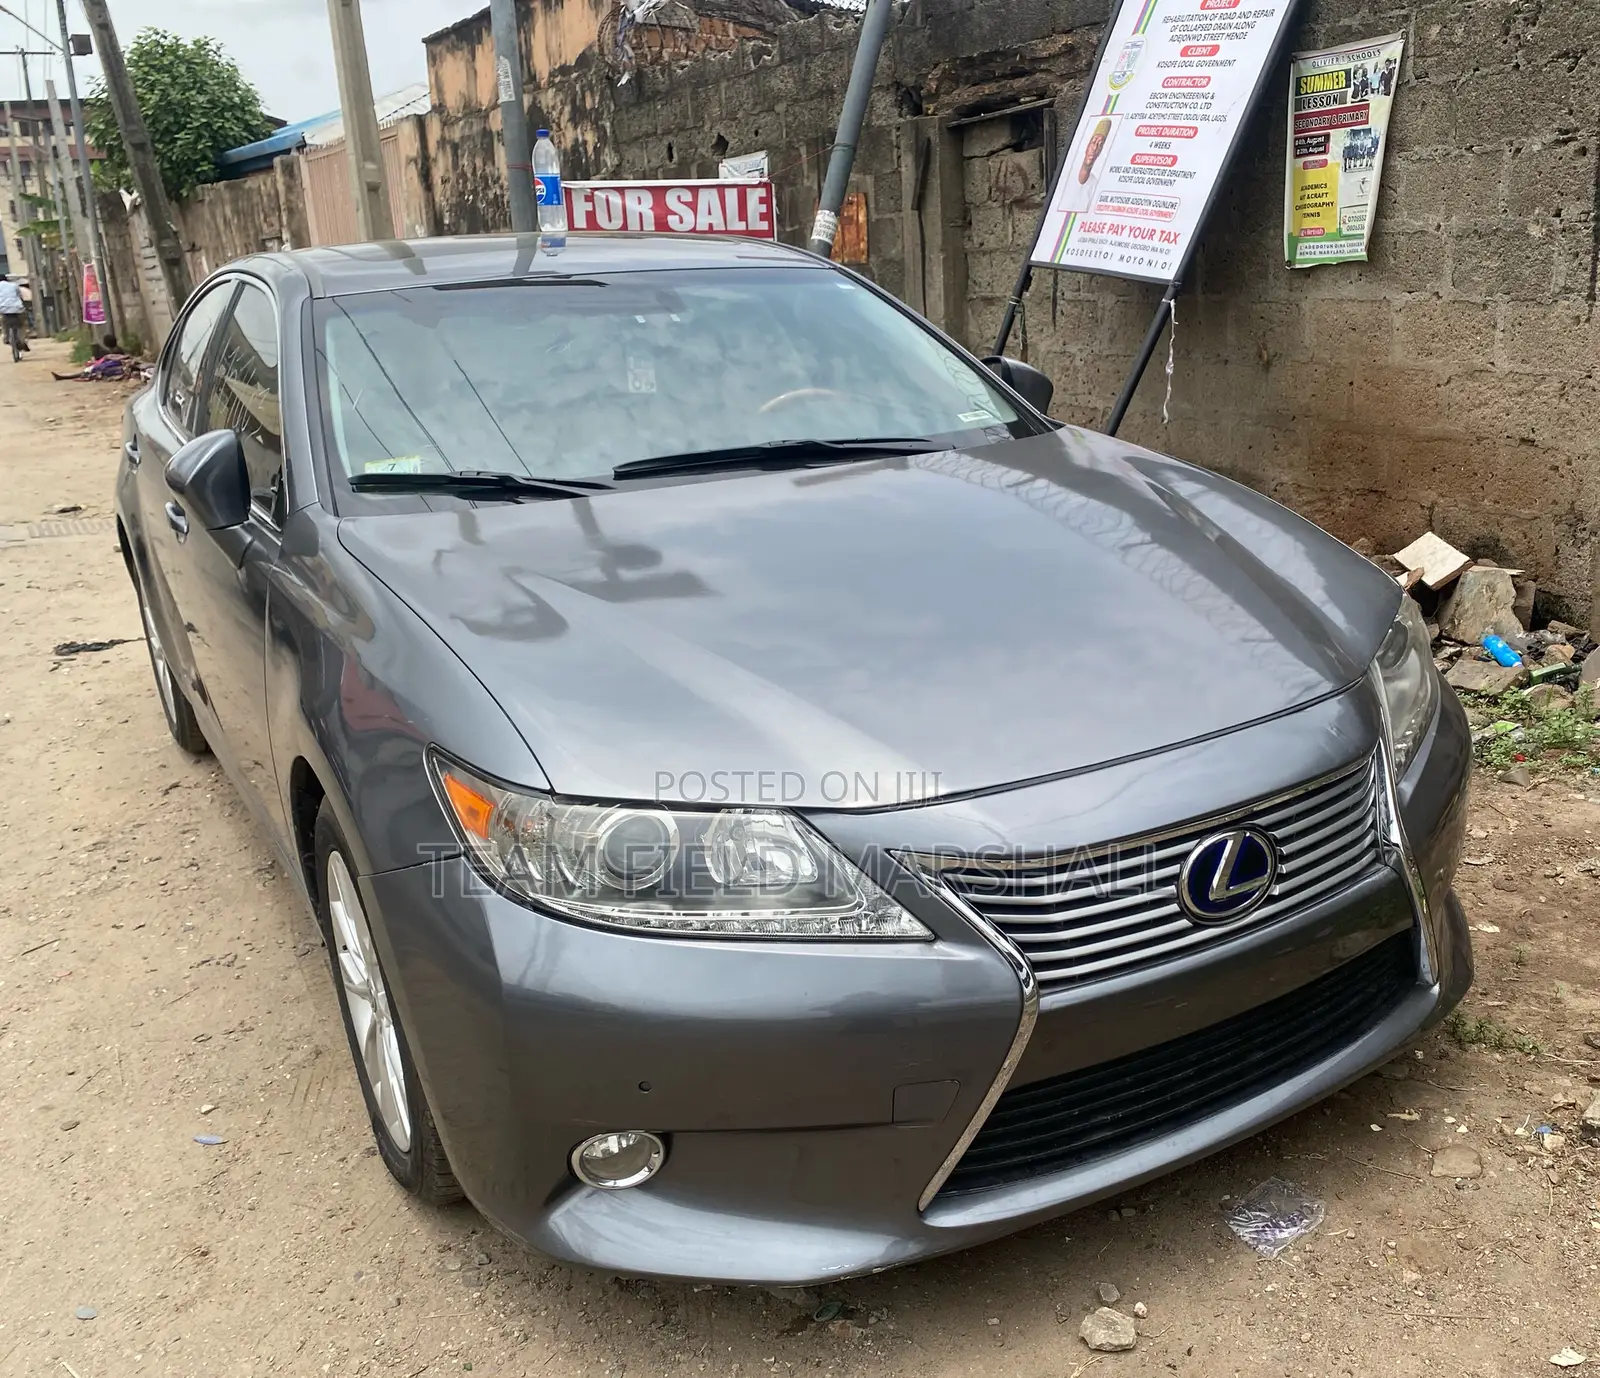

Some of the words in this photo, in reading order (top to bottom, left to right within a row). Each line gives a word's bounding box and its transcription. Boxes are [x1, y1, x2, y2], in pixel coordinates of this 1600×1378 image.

[1162, 14, 1208, 23] REHABILITATION
[1220, 12, 1236, 20] ROAD
[1252, 9, 1275, 18] REPAIR
[1179, 23, 1212, 32] COLLAPSED
[1233, 21, 1257, 30] ALONG
[1347, 49, 1381, 62] SCHOOLS
[1300, 71, 1346, 94] SUMMER
[1302, 94, 1339, 110] LESSON
[1295, 115, 1332, 130] SECONDARY
[1332, 114, 1337, 125] &
[1338, 109, 1368, 123] PRIMARY
[1138, 127, 1162, 135] PROJECT
[1162, 128, 1194, 136] DURATION
[1306, 136, 1324, 145] August
[1134, 156, 1173, 165] SUPERVISOR
[572, 188, 655, 231] FOR
[666, 187, 769, 232] SALE
[1078, 221, 1107, 234] PLEASE
[1107, 224, 1126, 236] PAY
[1128, 226, 1157, 240] YOUR
[1158, 230, 1181, 245] TAX
